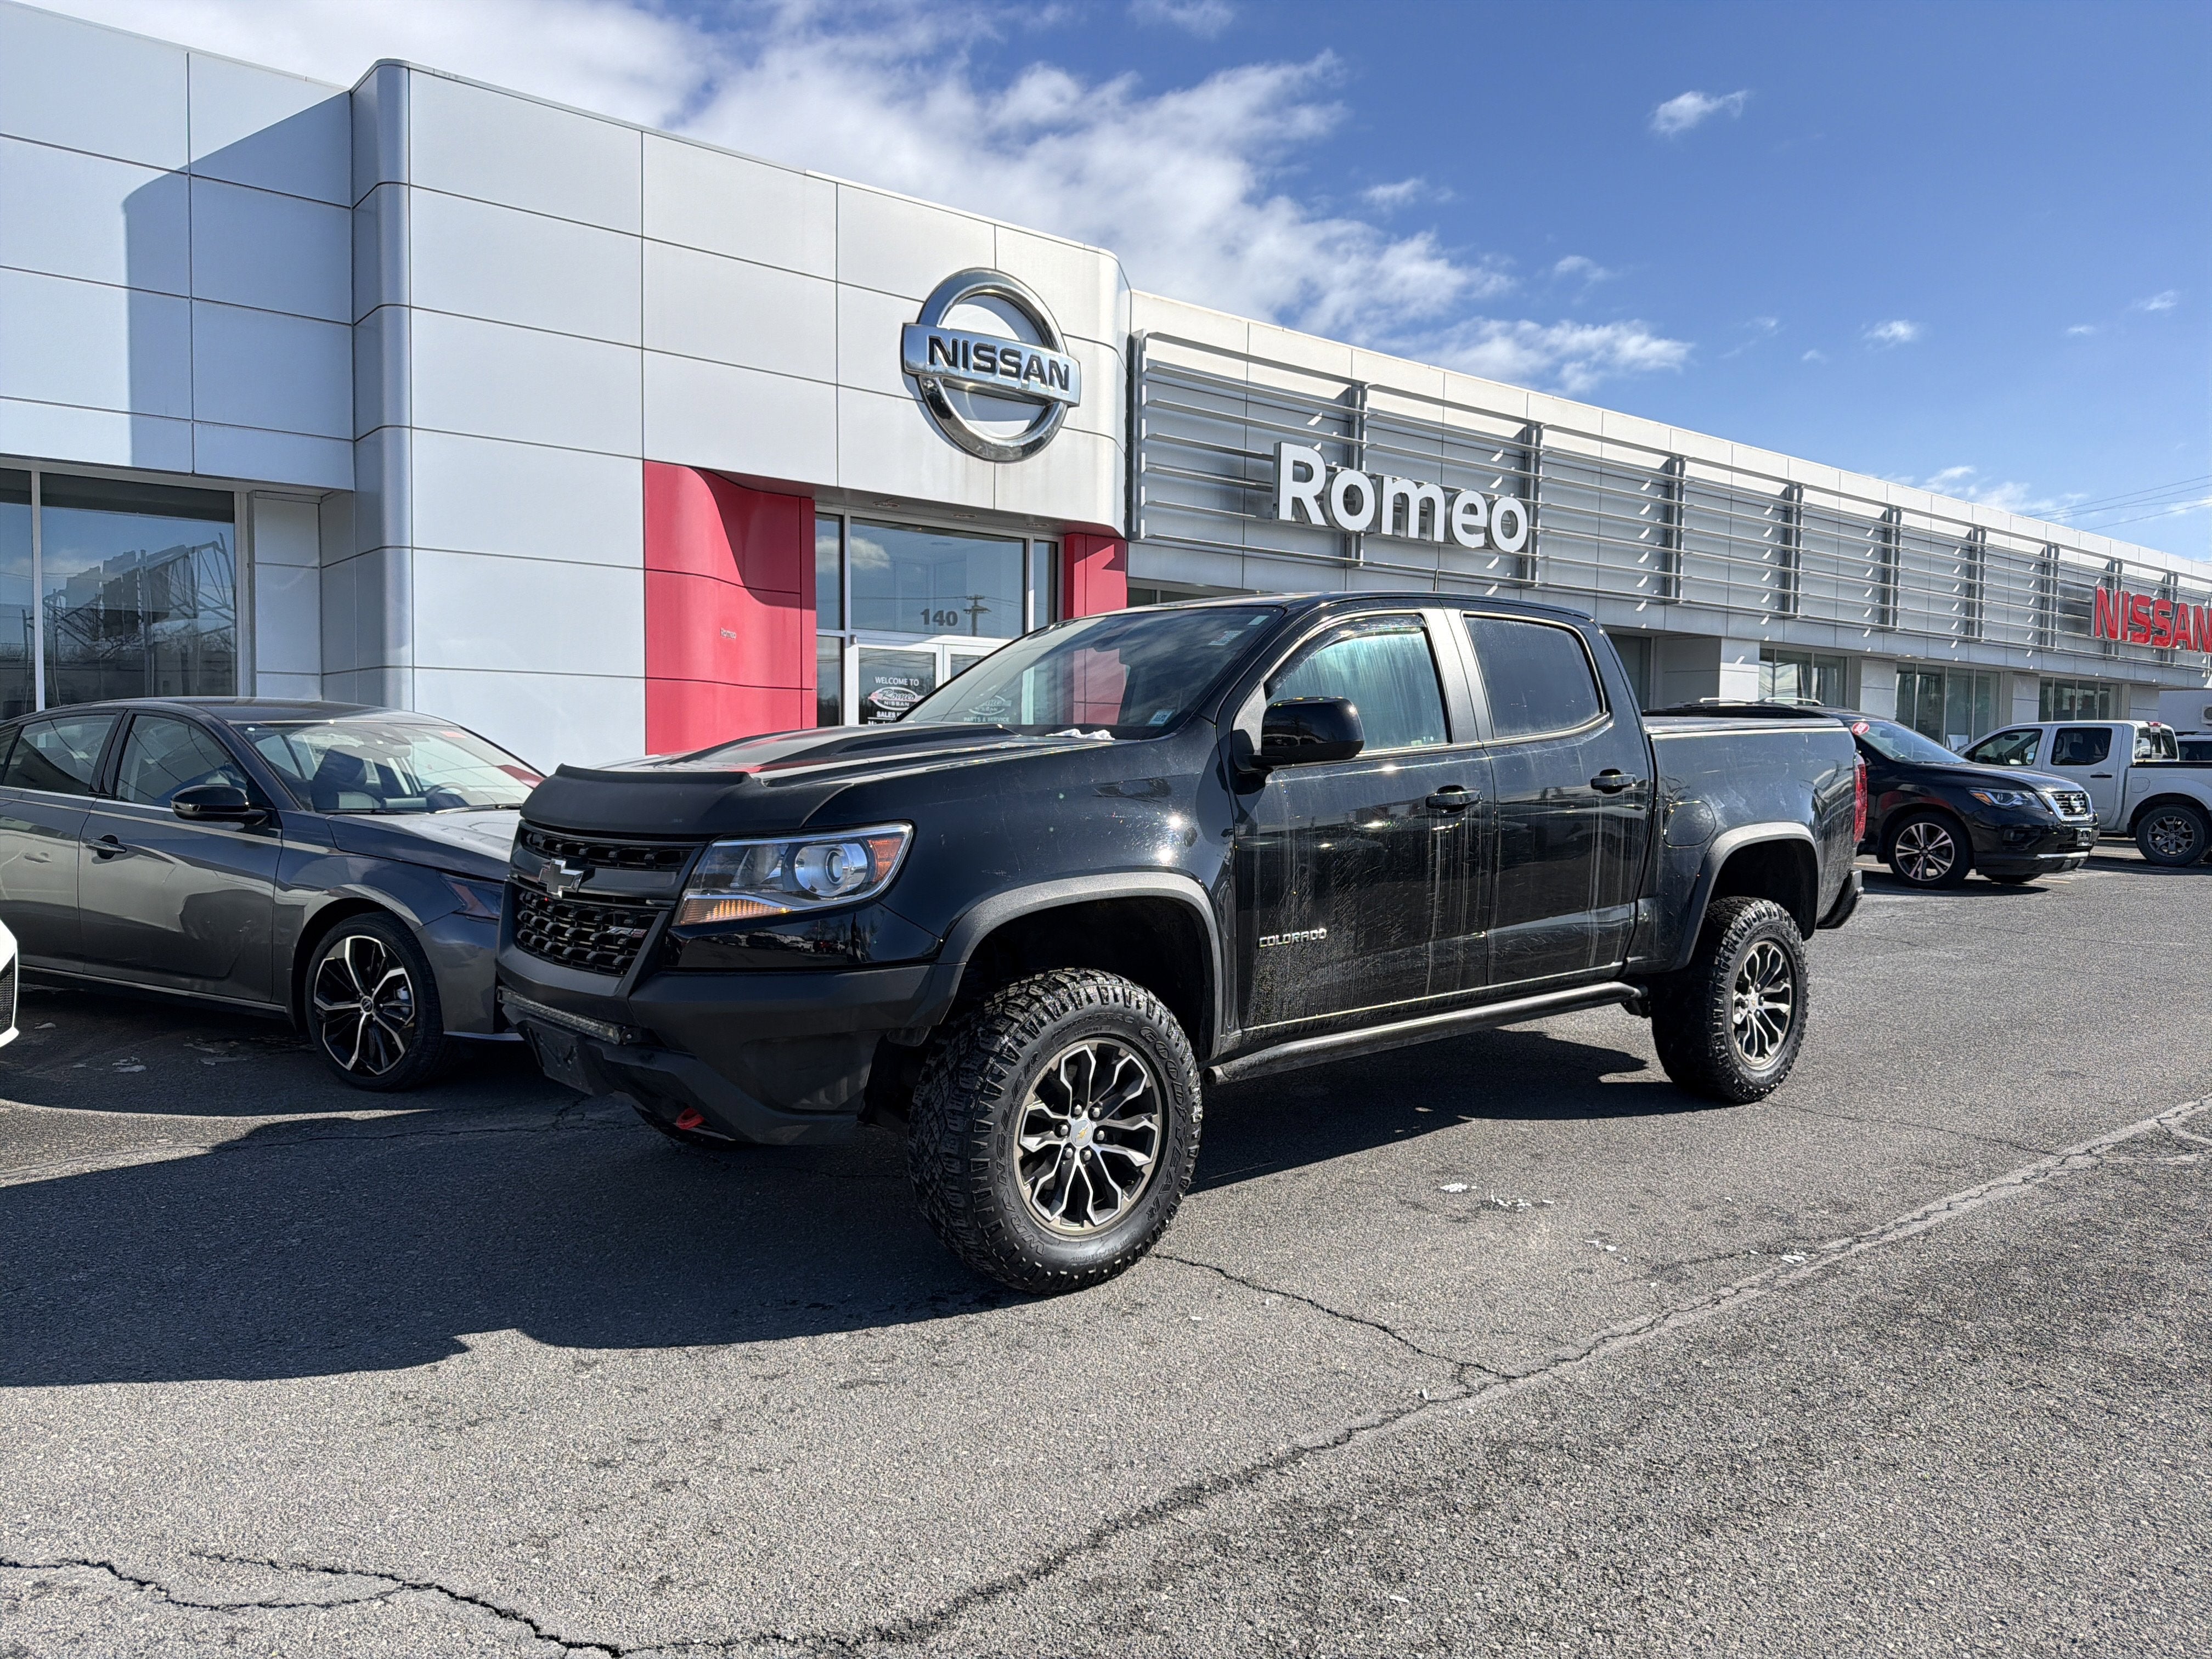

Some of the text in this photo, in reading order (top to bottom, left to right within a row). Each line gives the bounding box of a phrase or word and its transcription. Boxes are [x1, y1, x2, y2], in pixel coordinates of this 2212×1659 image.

[927, 335, 1070, 394] NISSAN
[1275, 441, 1528, 553] Romeo
[921, 608, 958, 626] 140
[2092, 585, 2212, 653] NISSAN
[875, 676, 908, 685] WELCOME
[879, 689, 915, 700] Romeo
[1259, 928, 1327, 948] COLORADO
[996, 1051, 1045, 1256] WRANGLER
[1139, 1026, 1187, 1222] GOODYEAR
